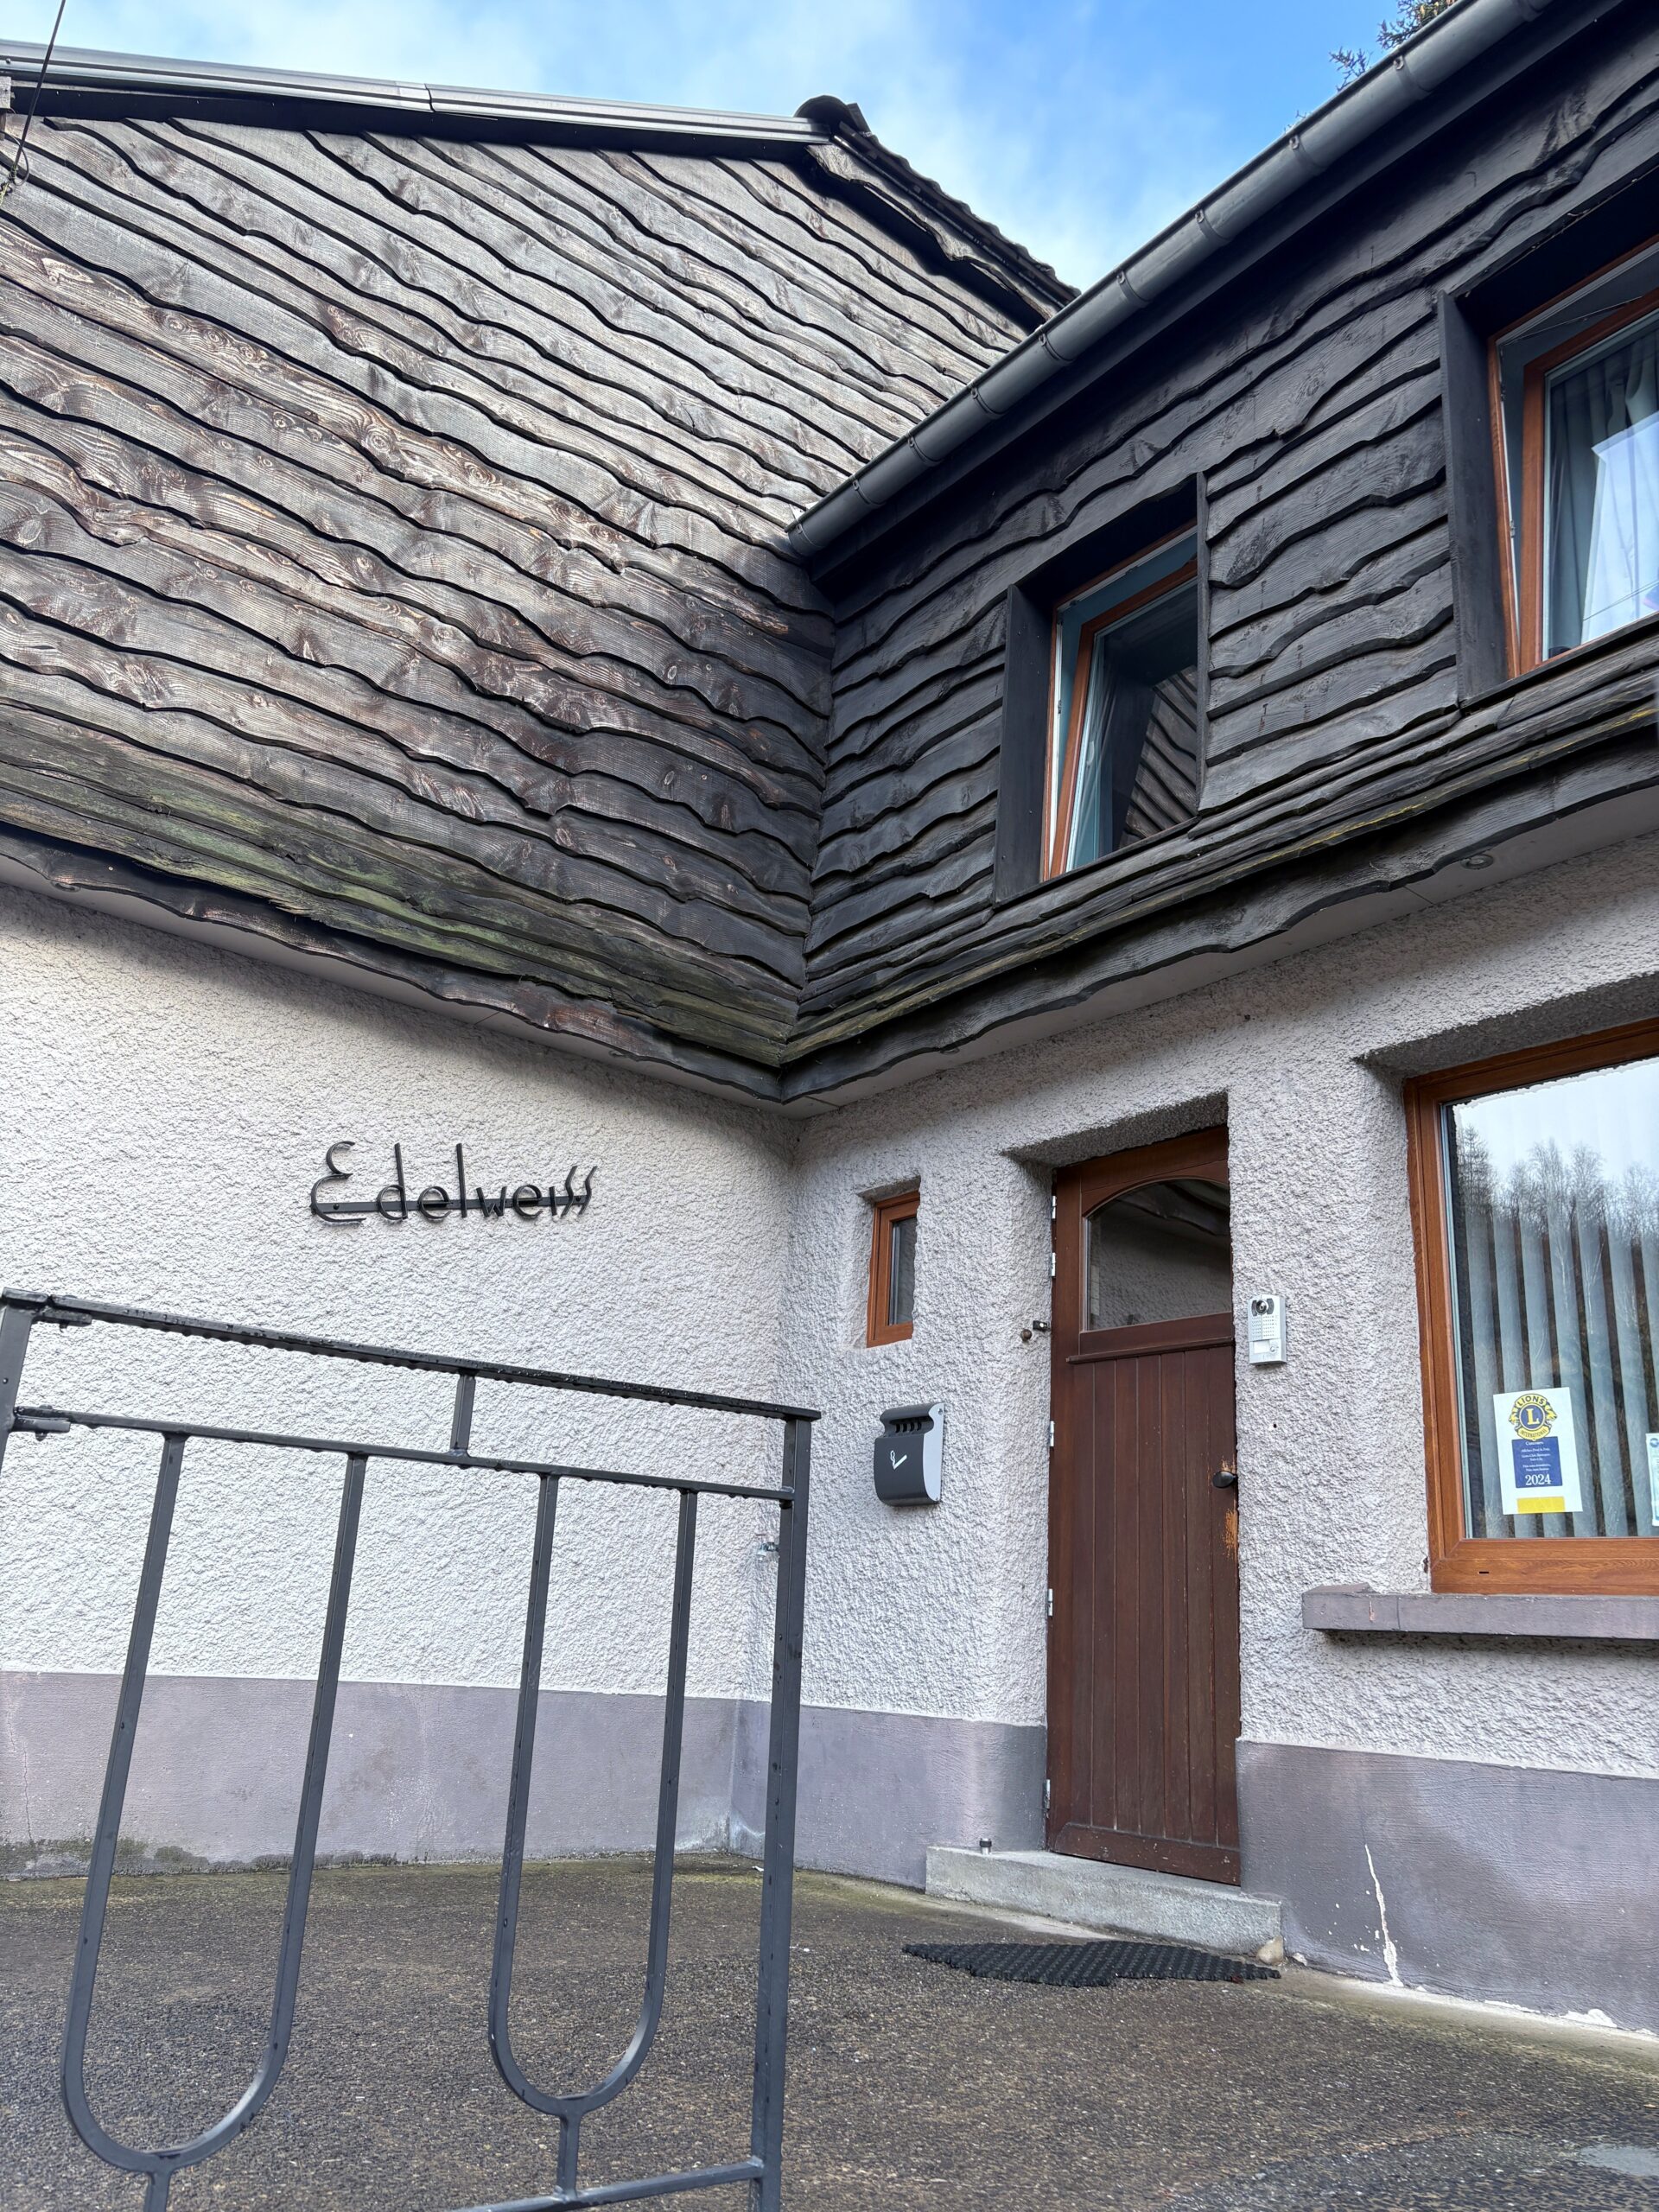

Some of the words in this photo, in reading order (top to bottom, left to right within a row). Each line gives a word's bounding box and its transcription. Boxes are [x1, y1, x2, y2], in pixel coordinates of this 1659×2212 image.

[310, 1140, 598, 1223] Edelweiss
[1516, 1395, 1545, 1407] LIONS
[1526, 1408, 1540, 1425] L
[1524, 1473, 1552, 1486] 2024
